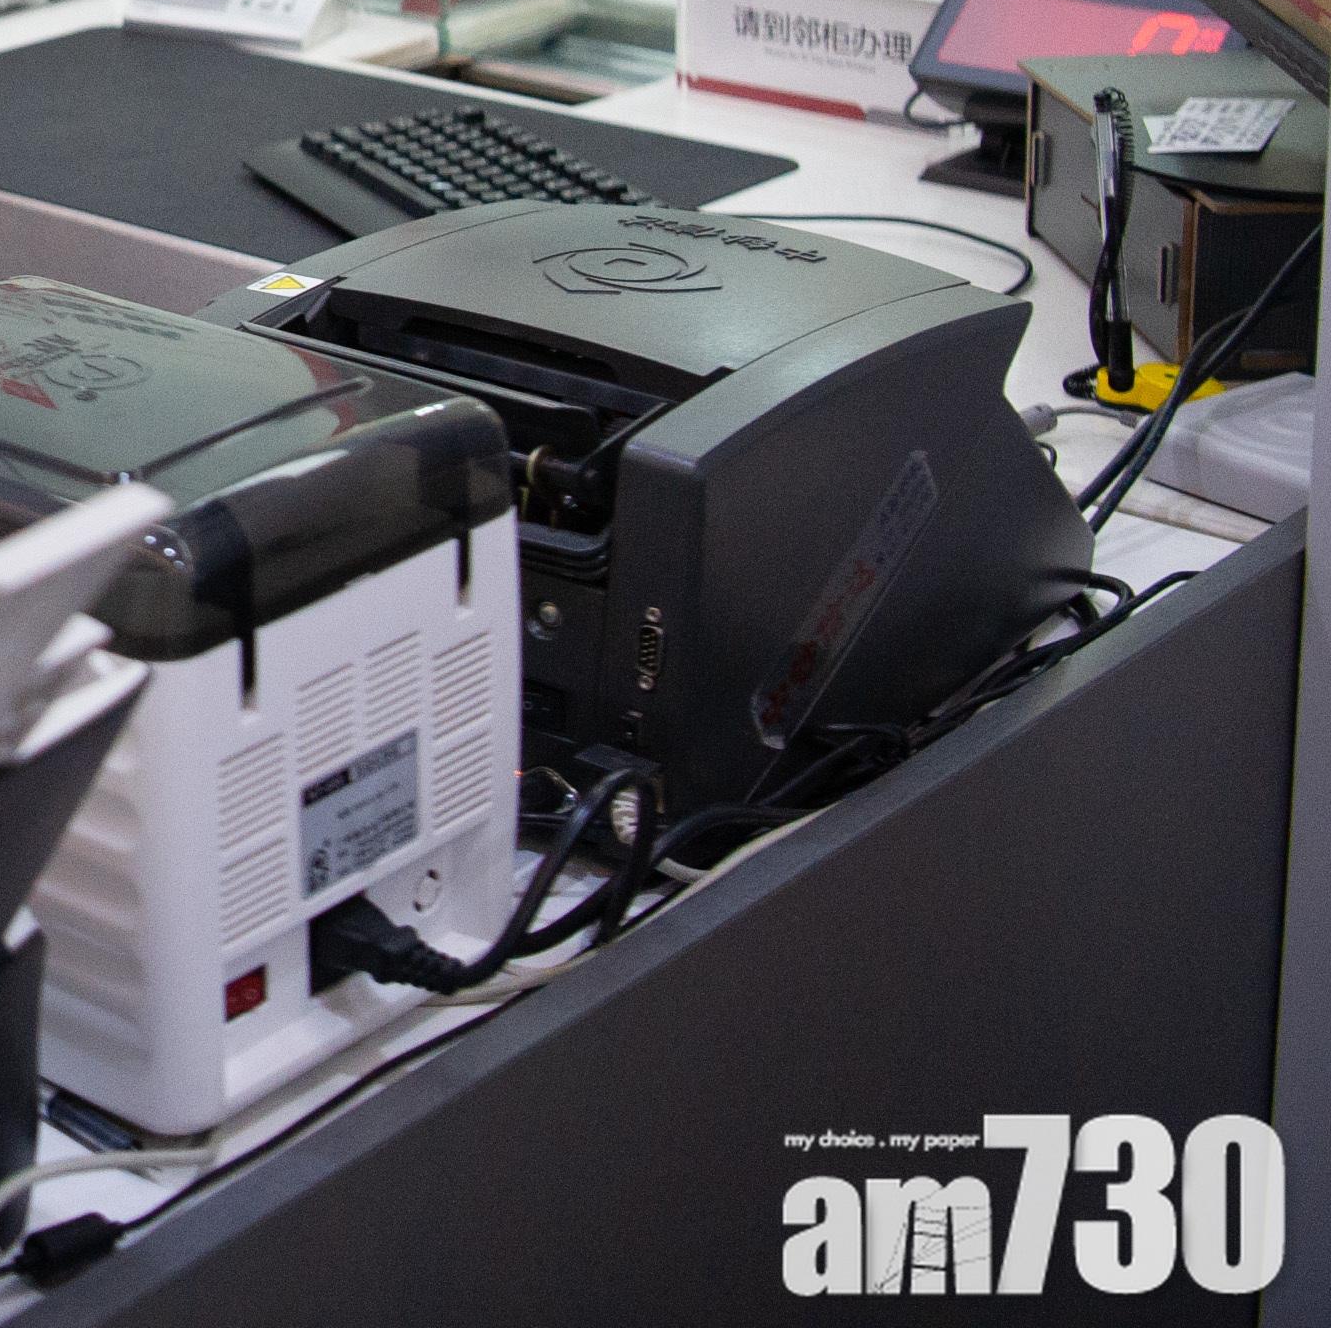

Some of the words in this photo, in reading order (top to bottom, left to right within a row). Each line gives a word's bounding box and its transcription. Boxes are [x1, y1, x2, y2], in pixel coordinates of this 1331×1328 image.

[734, 5, 913, 63] 请到邻柜办理
